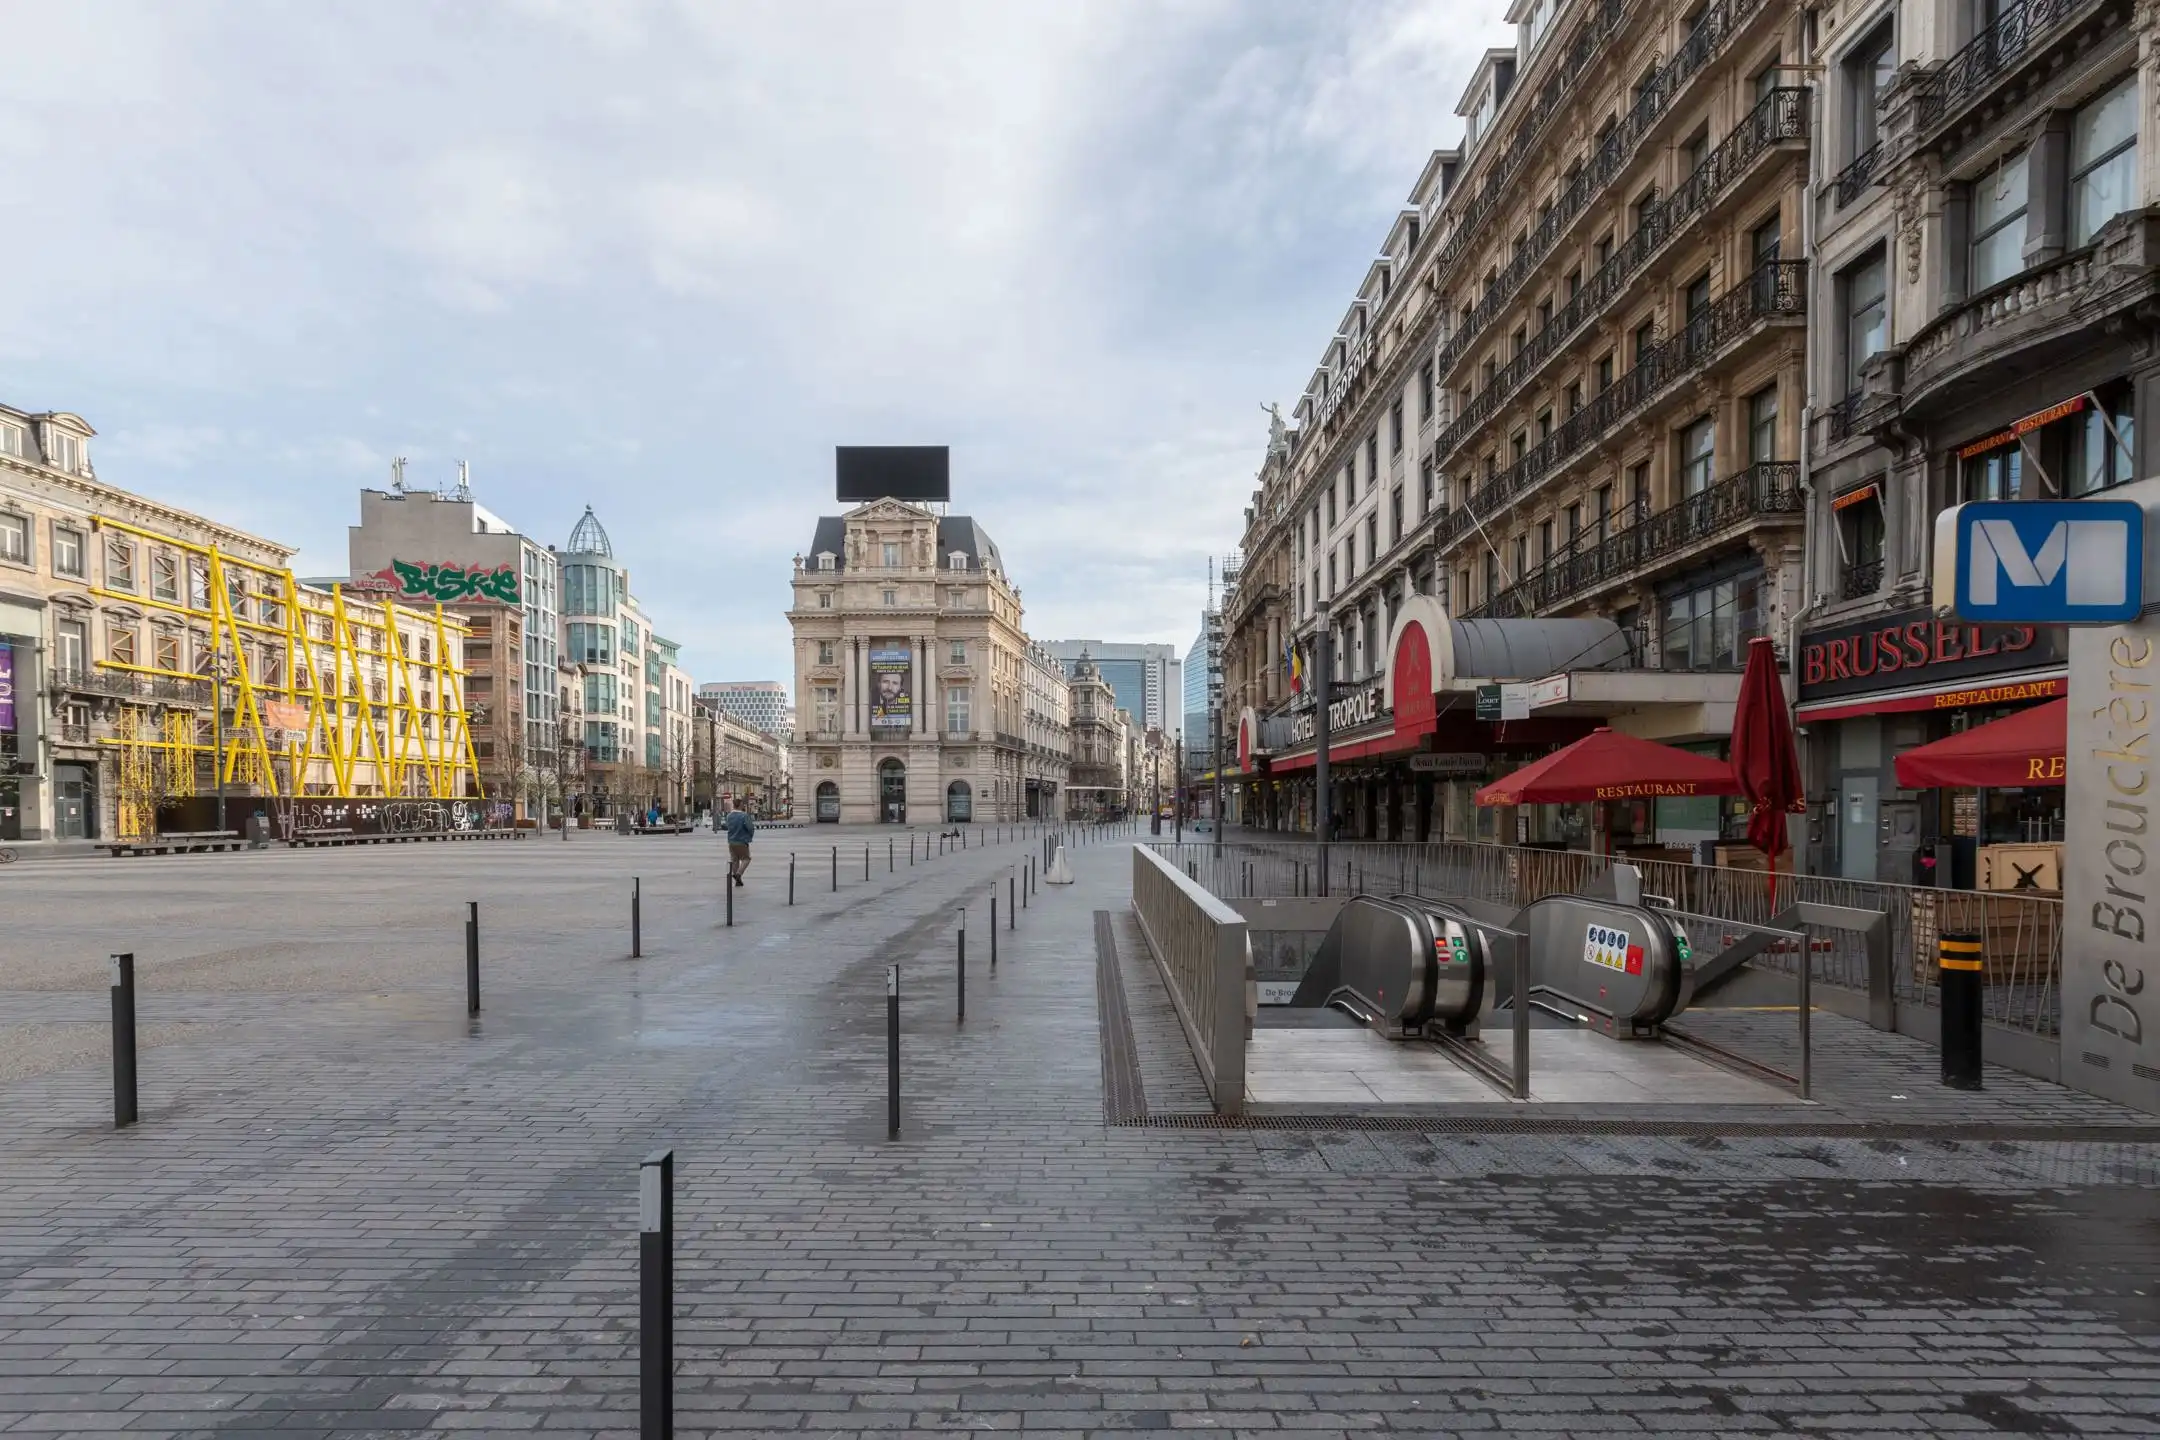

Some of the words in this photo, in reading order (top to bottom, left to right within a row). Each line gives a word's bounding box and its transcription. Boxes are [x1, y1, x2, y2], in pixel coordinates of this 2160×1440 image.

[1320, 332, 1374, 429] METROPOLE
[2018, 401, 2075, 433] RESTAURANT
[1963, 432, 2010, 457] RESTAURANT
[1969, 520, 2128, 605] M
[1291, 713, 1314, 743] HOTEL
[1328, 688, 1376, 731] TROPOLE
[1934, 680, 2056, 708] RESTAURANT
[2026, 756, 2066, 779] RE
[2091, 635, 2152, 943] Brouckère
[1596, 783, 1697, 798] RESTAURANT
[2090, 960, 2144, 1045] De
